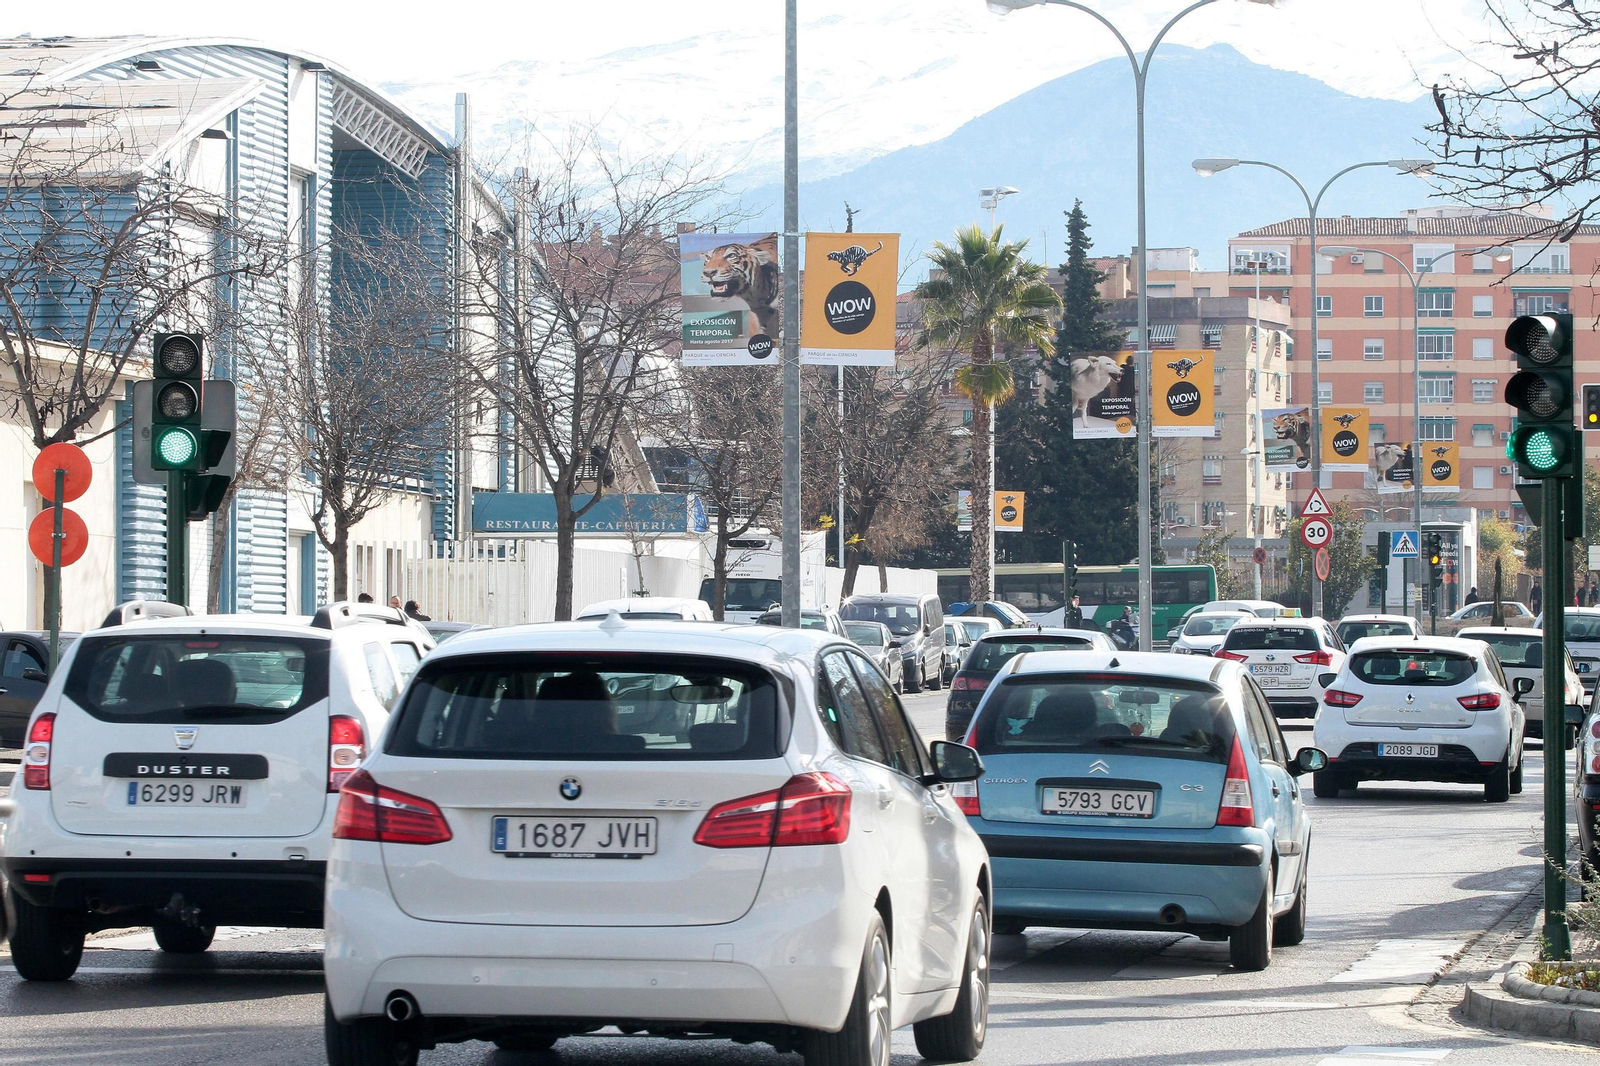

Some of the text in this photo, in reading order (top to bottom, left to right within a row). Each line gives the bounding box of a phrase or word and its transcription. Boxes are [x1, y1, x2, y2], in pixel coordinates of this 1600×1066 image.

[827, 297, 872, 316] WOW
[690, 317, 736, 326] EXPOSICIÓN
[690, 329, 732, 337] TEMPORAL
[749, 341, 771, 351] WOW
[1168, 391, 1198, 404] WOW
[1334, 438, 1357, 447] WOW
[1432, 466, 1450, 474] WOW
[485, 519, 676, 530] RESTAURATE-CAFETERÍA
[1307, 527, 1326, 538] 30
[1254, 665, 1289, 673] 5579 HZR
[1385, 745, 1436, 756] 2089 JGD
[137, 765, 230, 775] DUSTER
[141, 784, 242, 804] 6299 JRW
[1058, 791, 1148, 812] 5793 GCV
[518, 822, 650, 848] 1687 JVH
[497, 837, 504, 845] E
